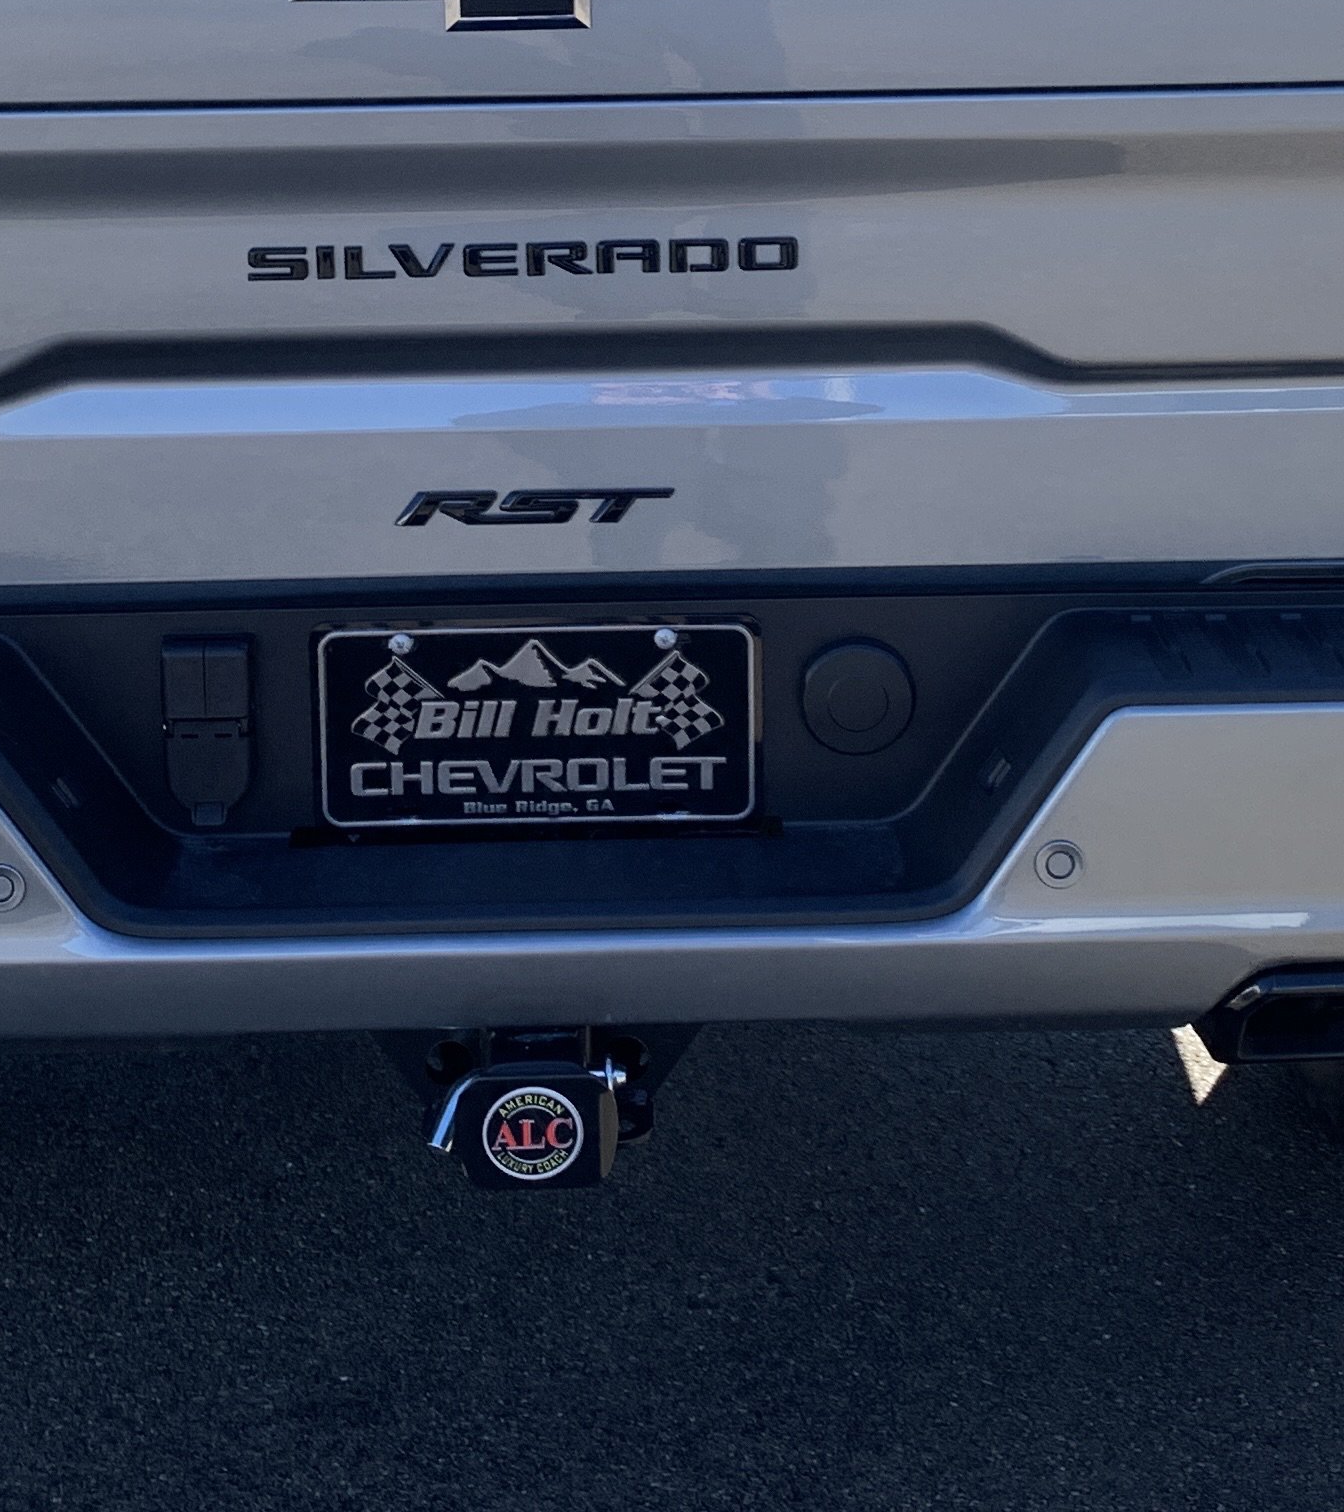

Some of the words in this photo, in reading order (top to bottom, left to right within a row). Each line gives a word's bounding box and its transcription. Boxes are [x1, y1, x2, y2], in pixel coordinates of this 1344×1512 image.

[246, 236, 799, 282] SILVERADO
[394, 487, 676, 526] RST
[413, 700, 518, 740] Bill
[531, 697, 663, 738] Holt
[350, 756, 727, 797] CHEVROLET
[463, 800, 508, 815] Blue
[515, 799, 579, 816] Ridge,
[586, 798, 615, 812] GA
[498, 1094, 565, 1118] AMERICAN
[491, 1117, 573, 1151] ALC
[496, 1151, 534, 1174] LUXURY
[536, 1150, 569, 1173] COACH
